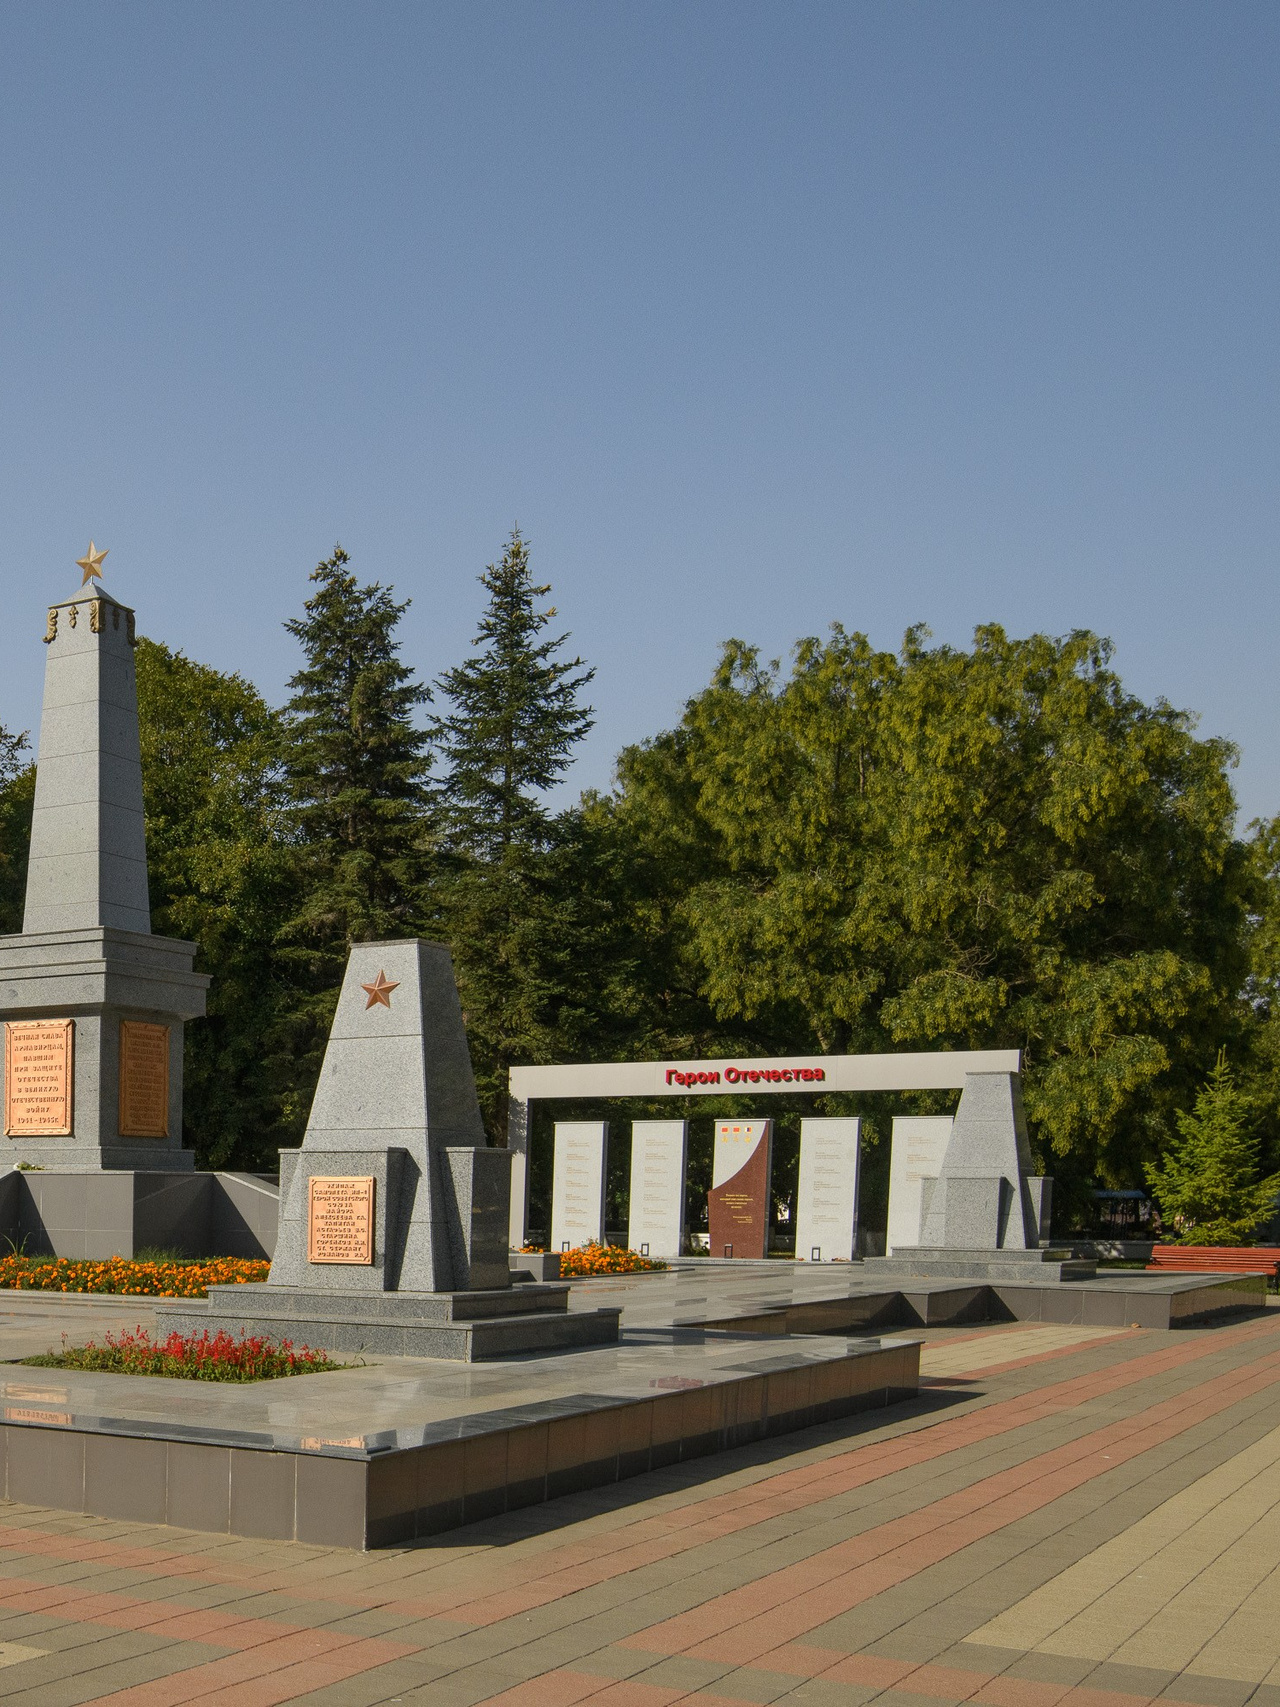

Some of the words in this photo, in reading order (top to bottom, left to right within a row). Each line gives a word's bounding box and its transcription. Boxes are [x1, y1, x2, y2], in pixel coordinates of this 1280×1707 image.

[665, 1069, 719, 1087] Герои
[724, 1067, 825, 1083] Отечества
[26, 1105, 50, 1113] ВОЙНУ
